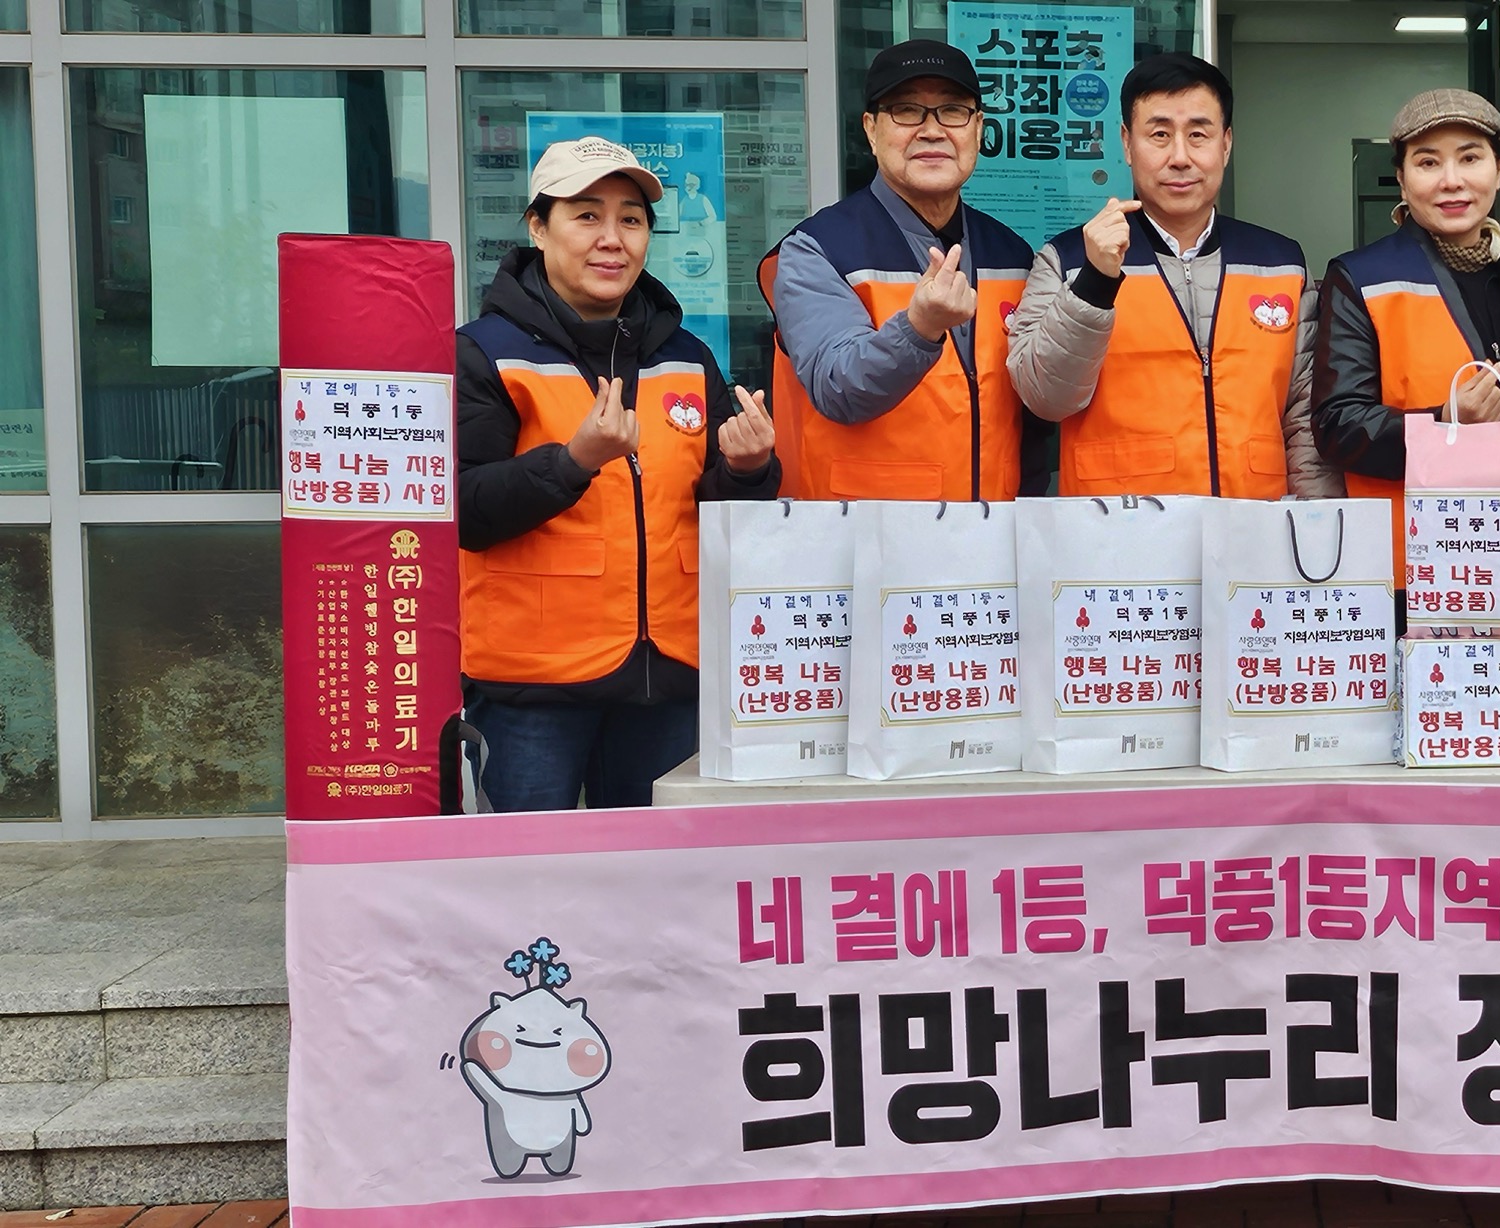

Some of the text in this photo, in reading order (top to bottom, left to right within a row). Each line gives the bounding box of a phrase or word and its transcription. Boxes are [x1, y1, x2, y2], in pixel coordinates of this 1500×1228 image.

[975, 28, 1106, 70] 스포츠
[978, 74, 1062, 115] 강좌
[980, 118, 1104, 160] 이용권
[325, 382, 357, 396] 곁에
[323, 426, 445, 442] 지역사회보장협의체
[289, 450, 445, 477] 행복 나눔 지원
[288, 478, 445, 505] (난방용품) 사업
[1437, 499, 1464, 512] 곁에
[1451, 565, 1493, 586] 나눔
[785, 595, 812, 608] 곁에
[933, 594, 958, 608] 곁에
[1108, 589, 1134, 602] 곁에
[1286, 590, 1310, 603] 곁에
[786, 635, 852, 650] 지역사회보
[1108, 628, 1202, 642] 지역사회보장협의
[1284, 628, 1386, 644] 지역사회보장협의체
[1464, 644, 1494, 657] 곁에
[740, 662, 842, 686] 행복 나눔
[892, 663, 936, 686] 행복
[948, 660, 987, 681] 나눔
[1064, 656, 1107, 678] 행복
[1122, 655, 1162, 675] 나눔
[1238, 653, 1386, 678] 행복 나눔 지원
[739, 688, 843, 714] (난방용품)
[890, 686, 990, 712] (난방용품)
[1064, 680, 1162, 704] (난방용품)
[1236, 679, 1386, 704] (난방용품) 사업
[1418, 711, 1464, 732] 행복
[737, 876, 804, 964] 네
[831, 870, 969, 962] 곁에
[993, 866, 1108, 955] 1등,
[738, 972, 1398, 1152] 희망나누리
